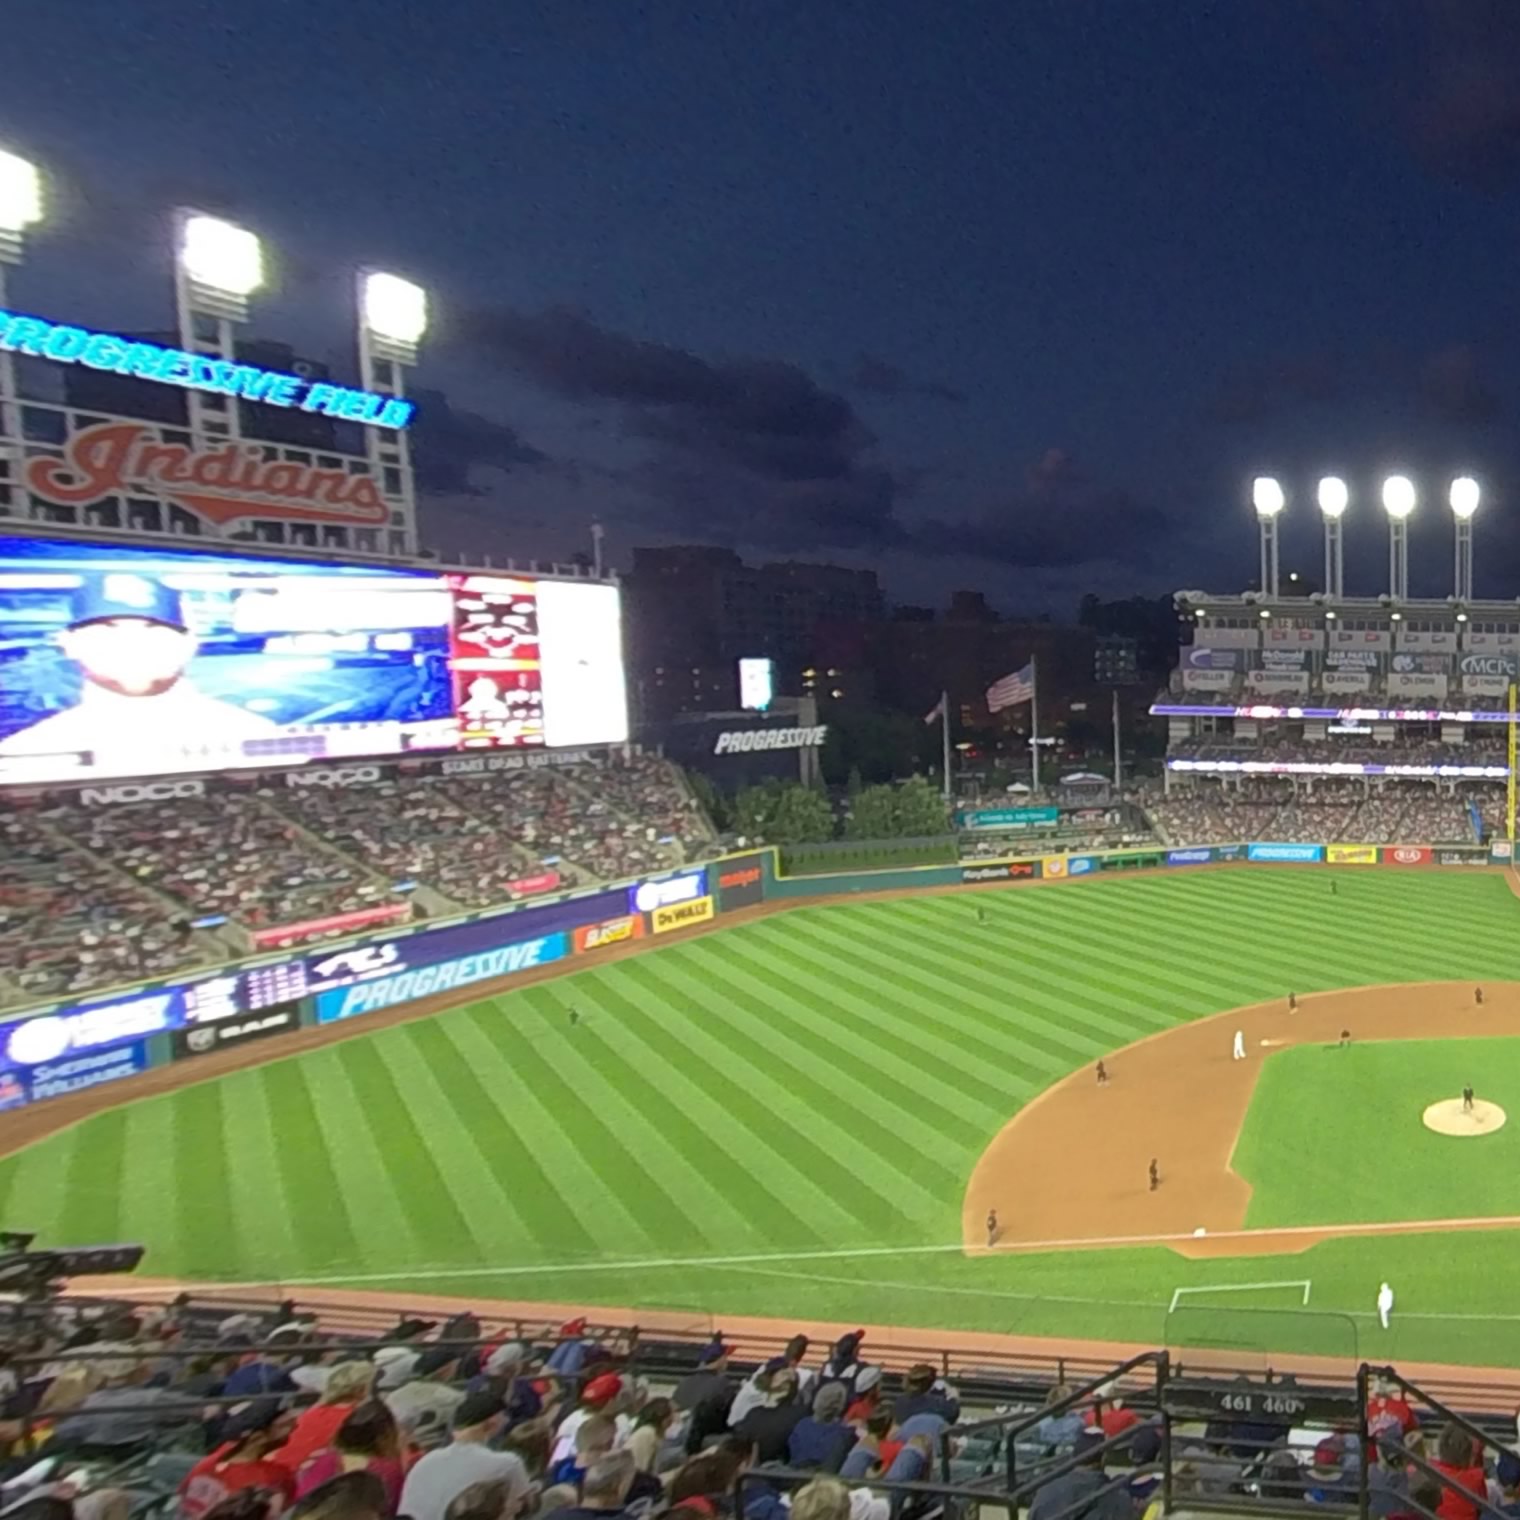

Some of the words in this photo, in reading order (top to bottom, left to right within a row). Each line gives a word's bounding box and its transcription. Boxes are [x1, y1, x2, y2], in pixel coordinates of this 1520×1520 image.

[0, 310, 302, 408] ROGRESSIVE
[302, 382, 412, 430] FIELD
[26, 422, 391, 526] Indians
[714, 725, 828, 755] PROGRESSIVE
[286, 766, 380, 789] NOCO
[80, 780, 205, 806] NOCO
[962, 866, 1010, 881] KeyBank
[337, 938, 547, 1019] PROGRESSIVE
[1221, 1394, 1252, 1411] 461
[1262, 1397, 1298, 1414] 460
